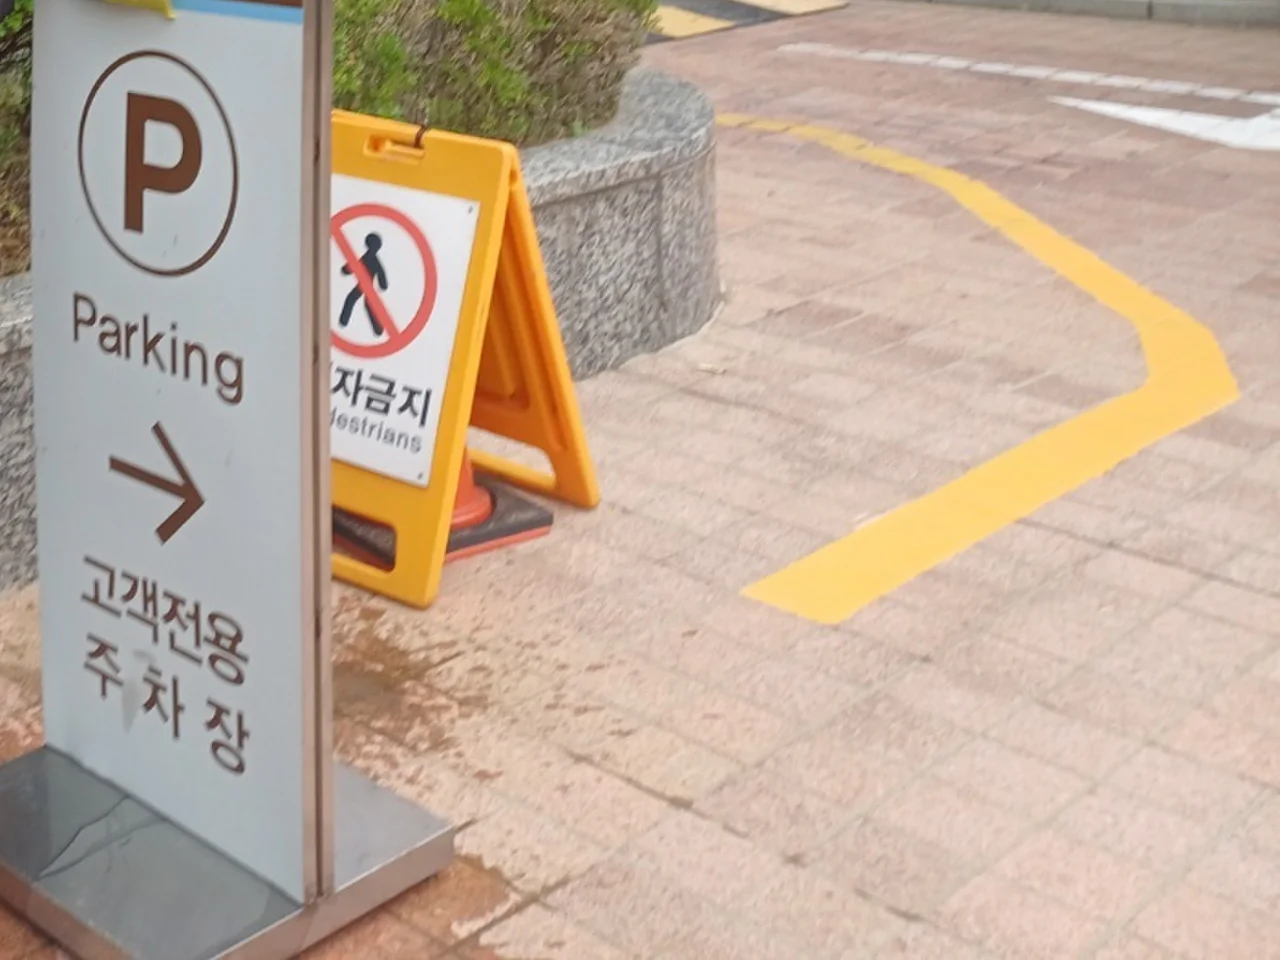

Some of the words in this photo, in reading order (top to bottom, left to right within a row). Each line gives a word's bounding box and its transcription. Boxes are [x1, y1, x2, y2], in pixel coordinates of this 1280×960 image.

[124, 91, 202, 234] P
[72, 291, 244, 405] Parking
[330, 362, 432, 428] 자금지
[81, 555, 249, 686] 고객전용
